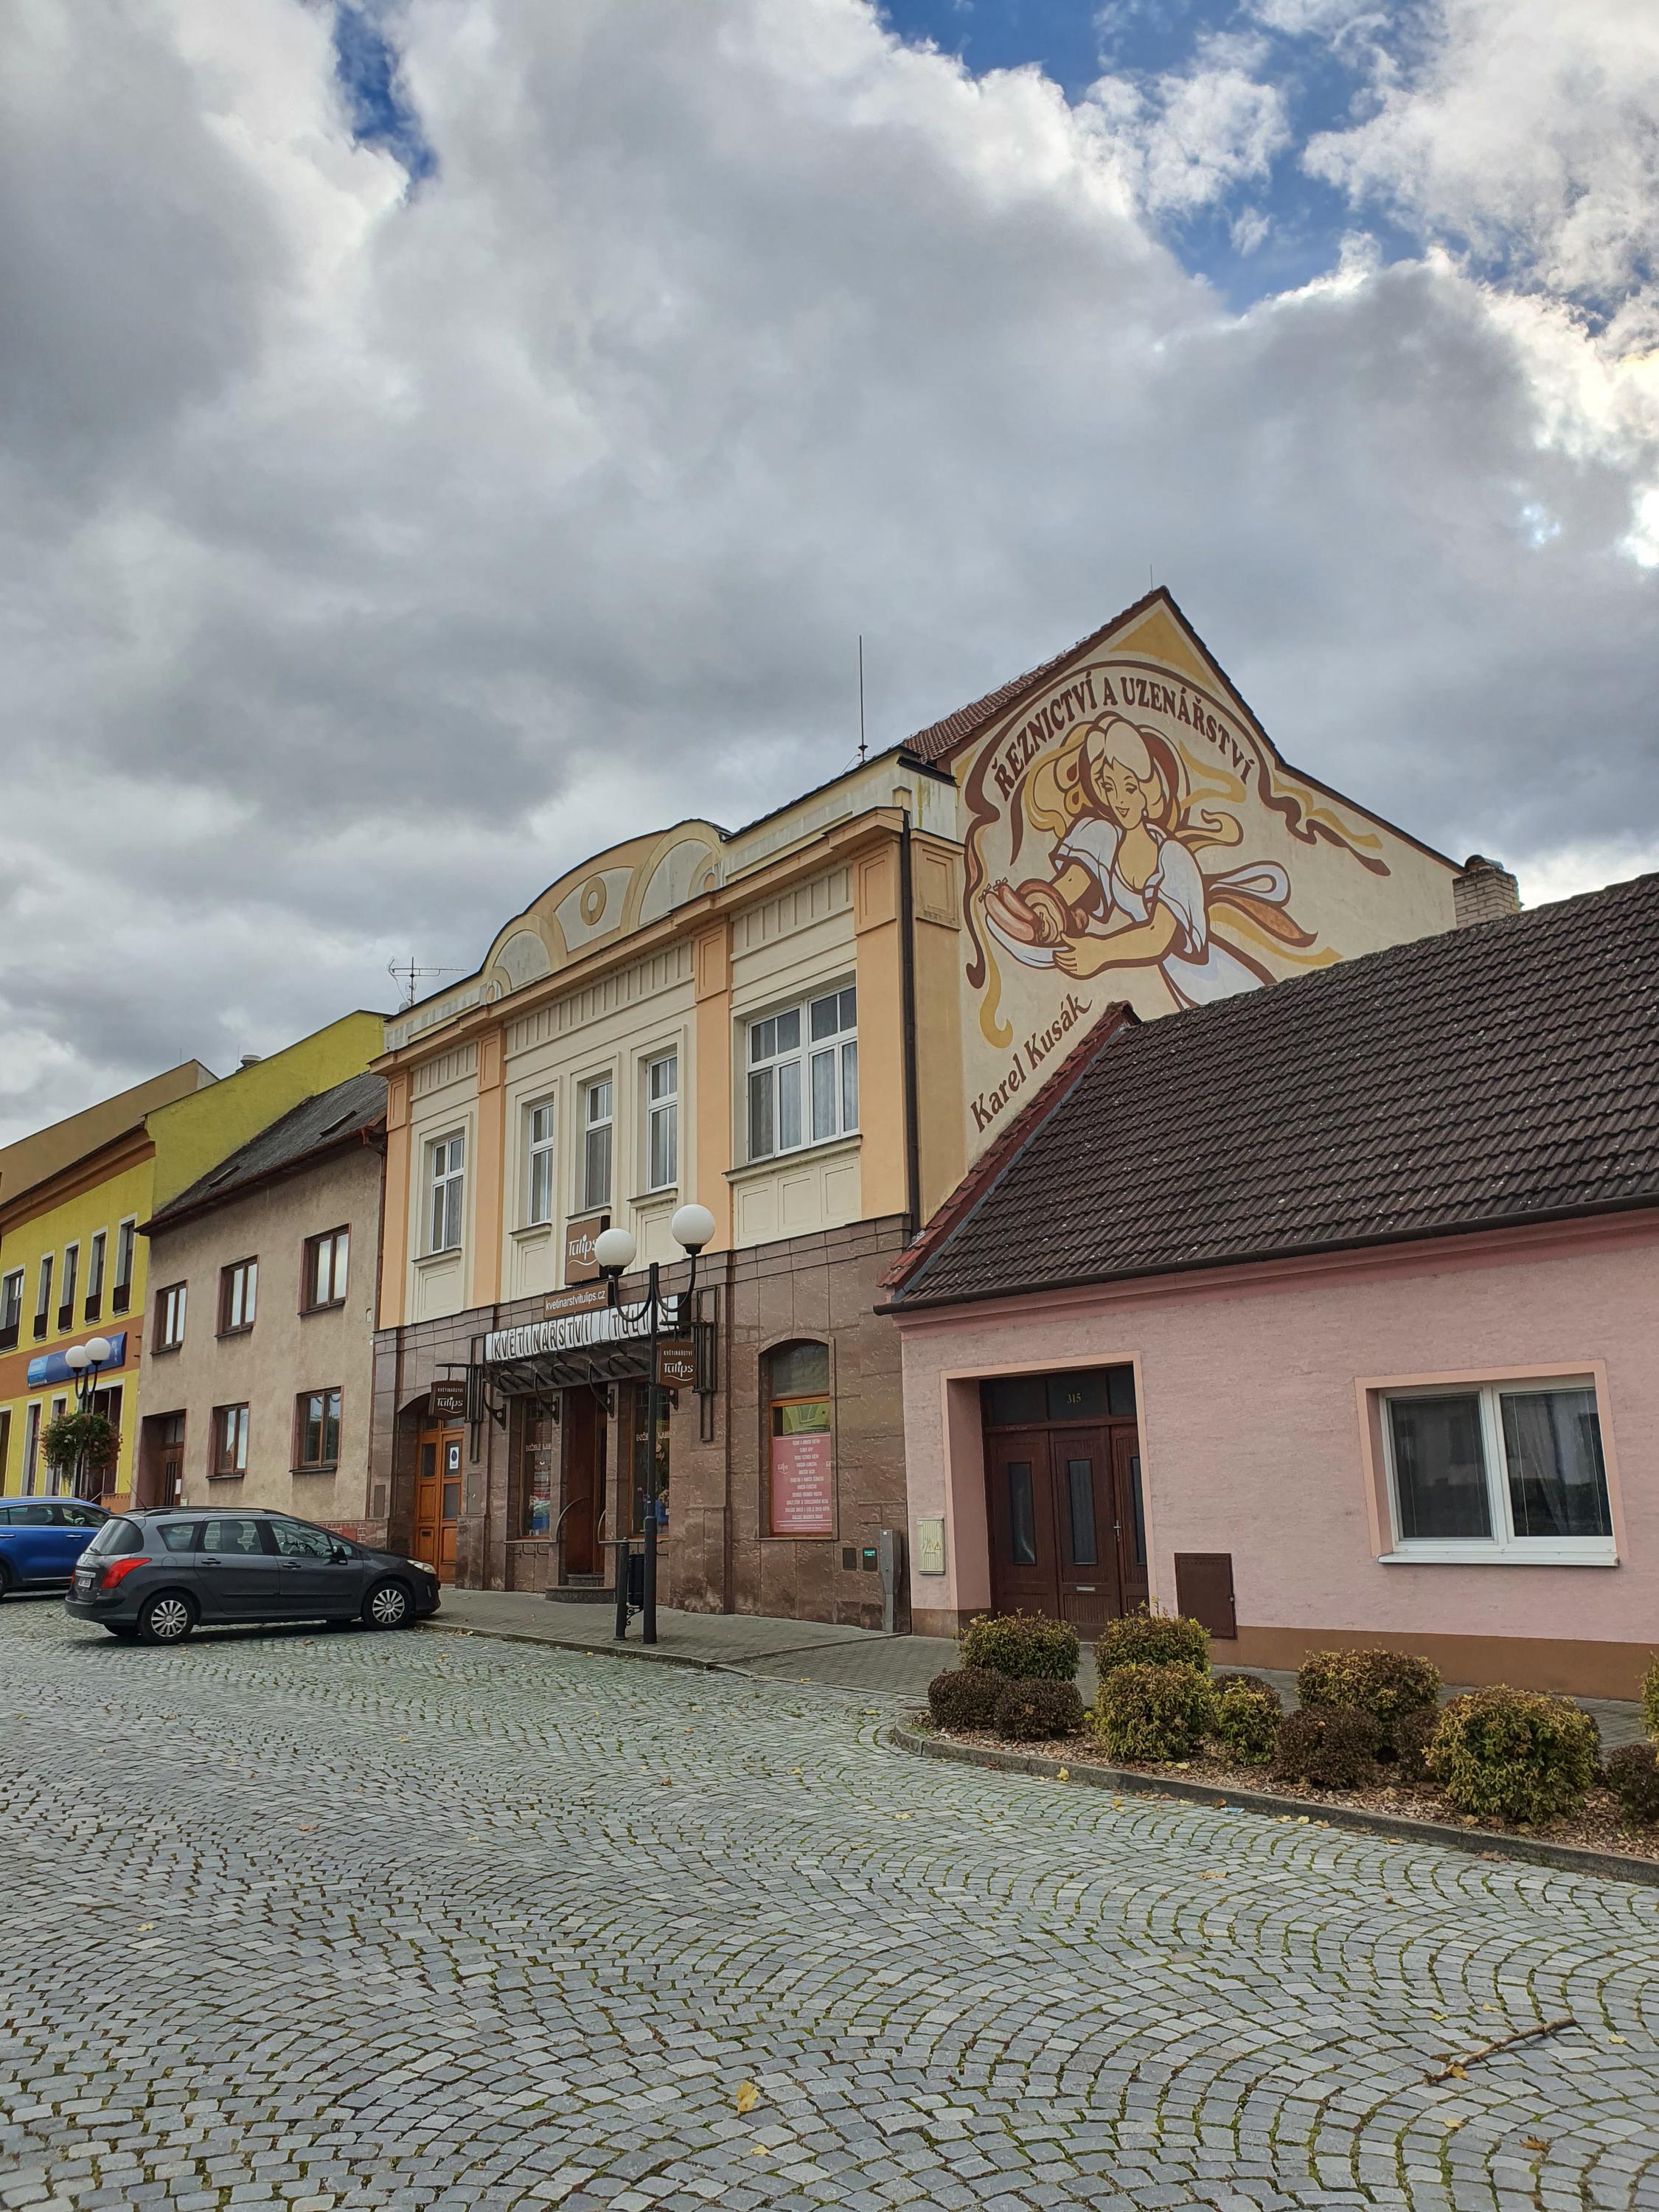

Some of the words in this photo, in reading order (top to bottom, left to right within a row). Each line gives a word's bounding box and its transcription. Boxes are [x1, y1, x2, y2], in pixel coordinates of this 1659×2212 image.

[992, 671, 1098, 801] ŘEZNICTVÍ
[1103, 677, 1119, 706] A
[1120, 676, 1256, 785] UZENÁŘSTVÍ
[970, 1053, 1027, 1133] Karel
[1023, 993, 1093, 1070] Kusák
[546, 1290, 606, 1312] kvetinarstvitulips.cz
[493, 1315, 590, 1360] KVĚTINÁŘSTVÍ
[663, 1360, 694, 1378] Tulips
[437, 1397, 464, 1411] Tulips
[1067, 1393, 1082, 1404] 315
